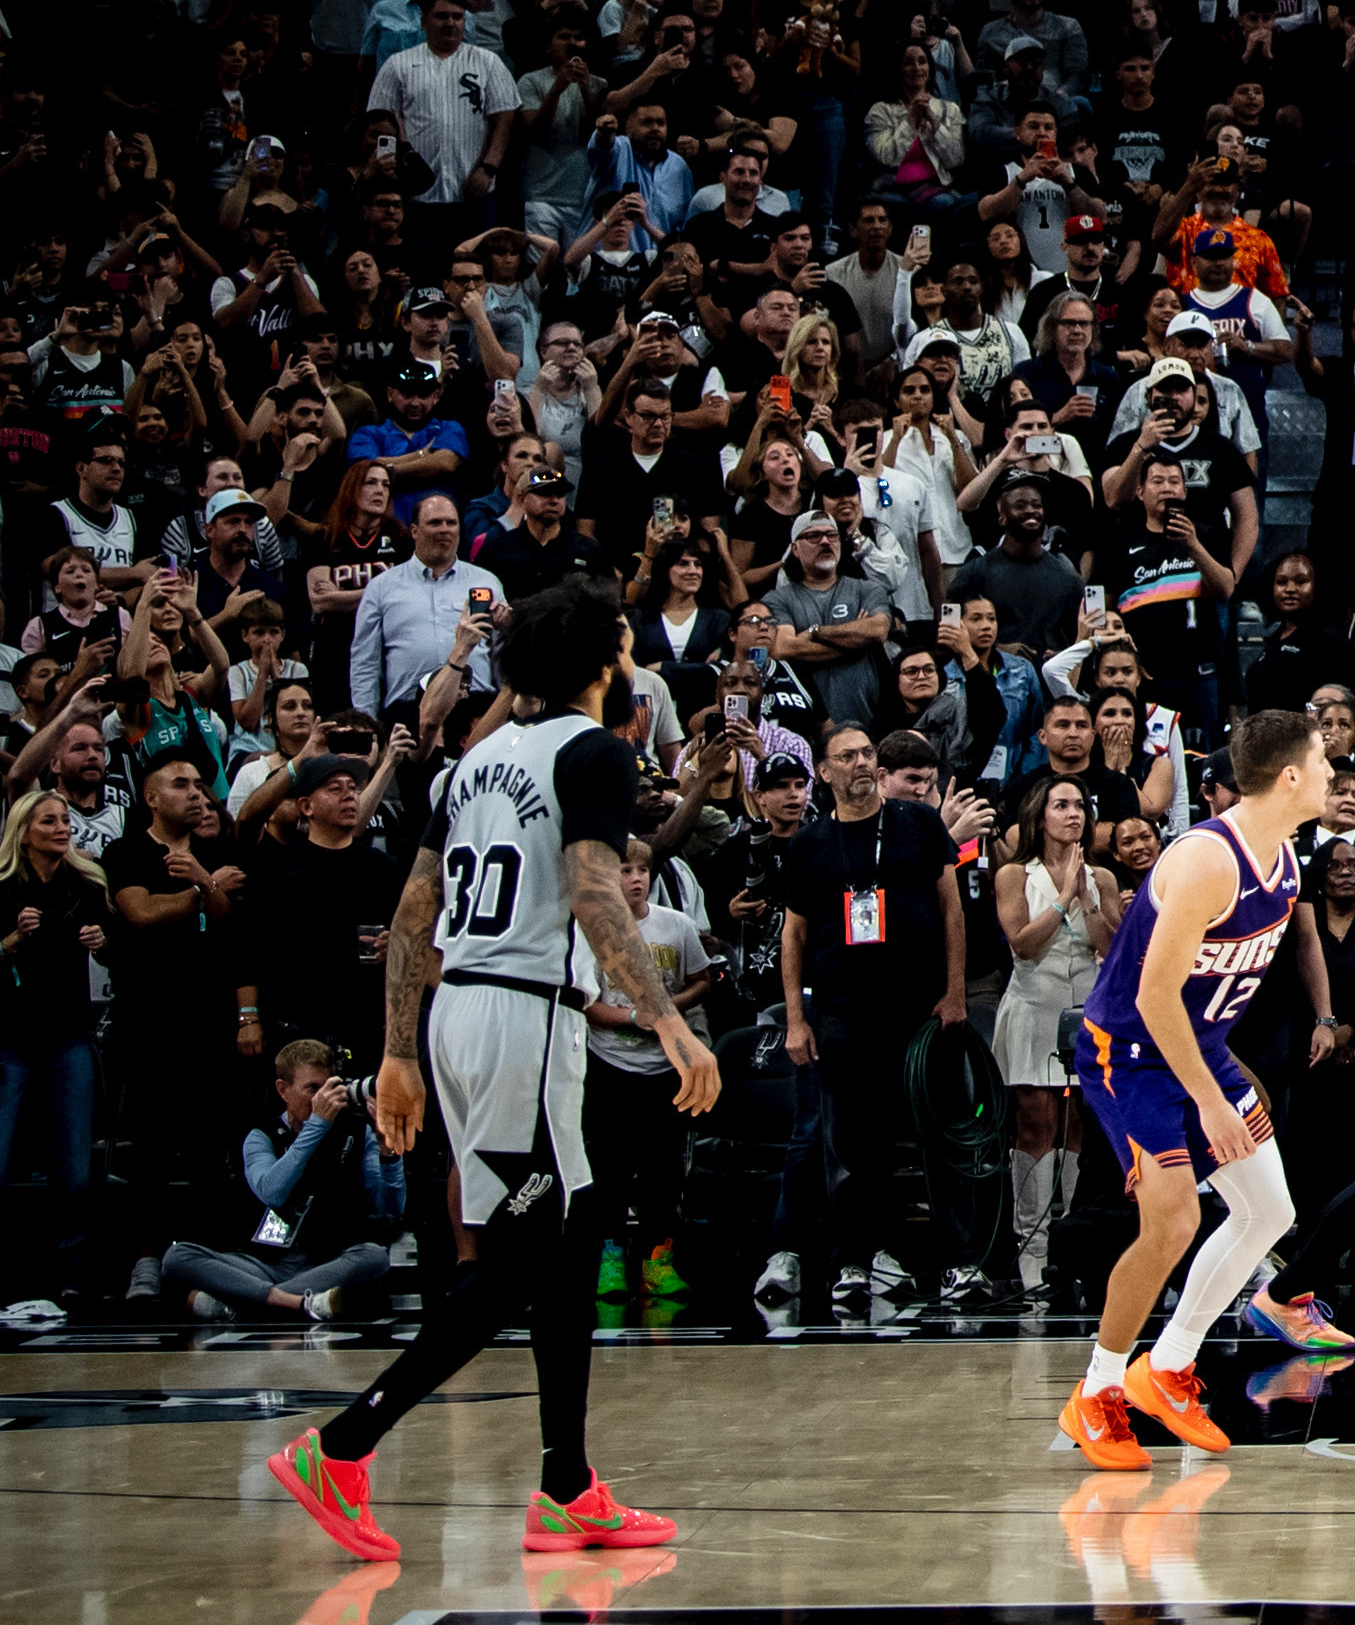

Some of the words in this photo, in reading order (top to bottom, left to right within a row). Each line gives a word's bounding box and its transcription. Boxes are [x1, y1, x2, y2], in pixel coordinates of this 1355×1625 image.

[1037, 206, 1051, 229] 1
[1130, 566, 1155, 585] San
[1156, 556, 1195, 578] Antonio
[446, 761, 551, 830] HAMPAGNIE
[444, 840, 526, 940] 30
[1202, 974, 1262, 1024] 12
